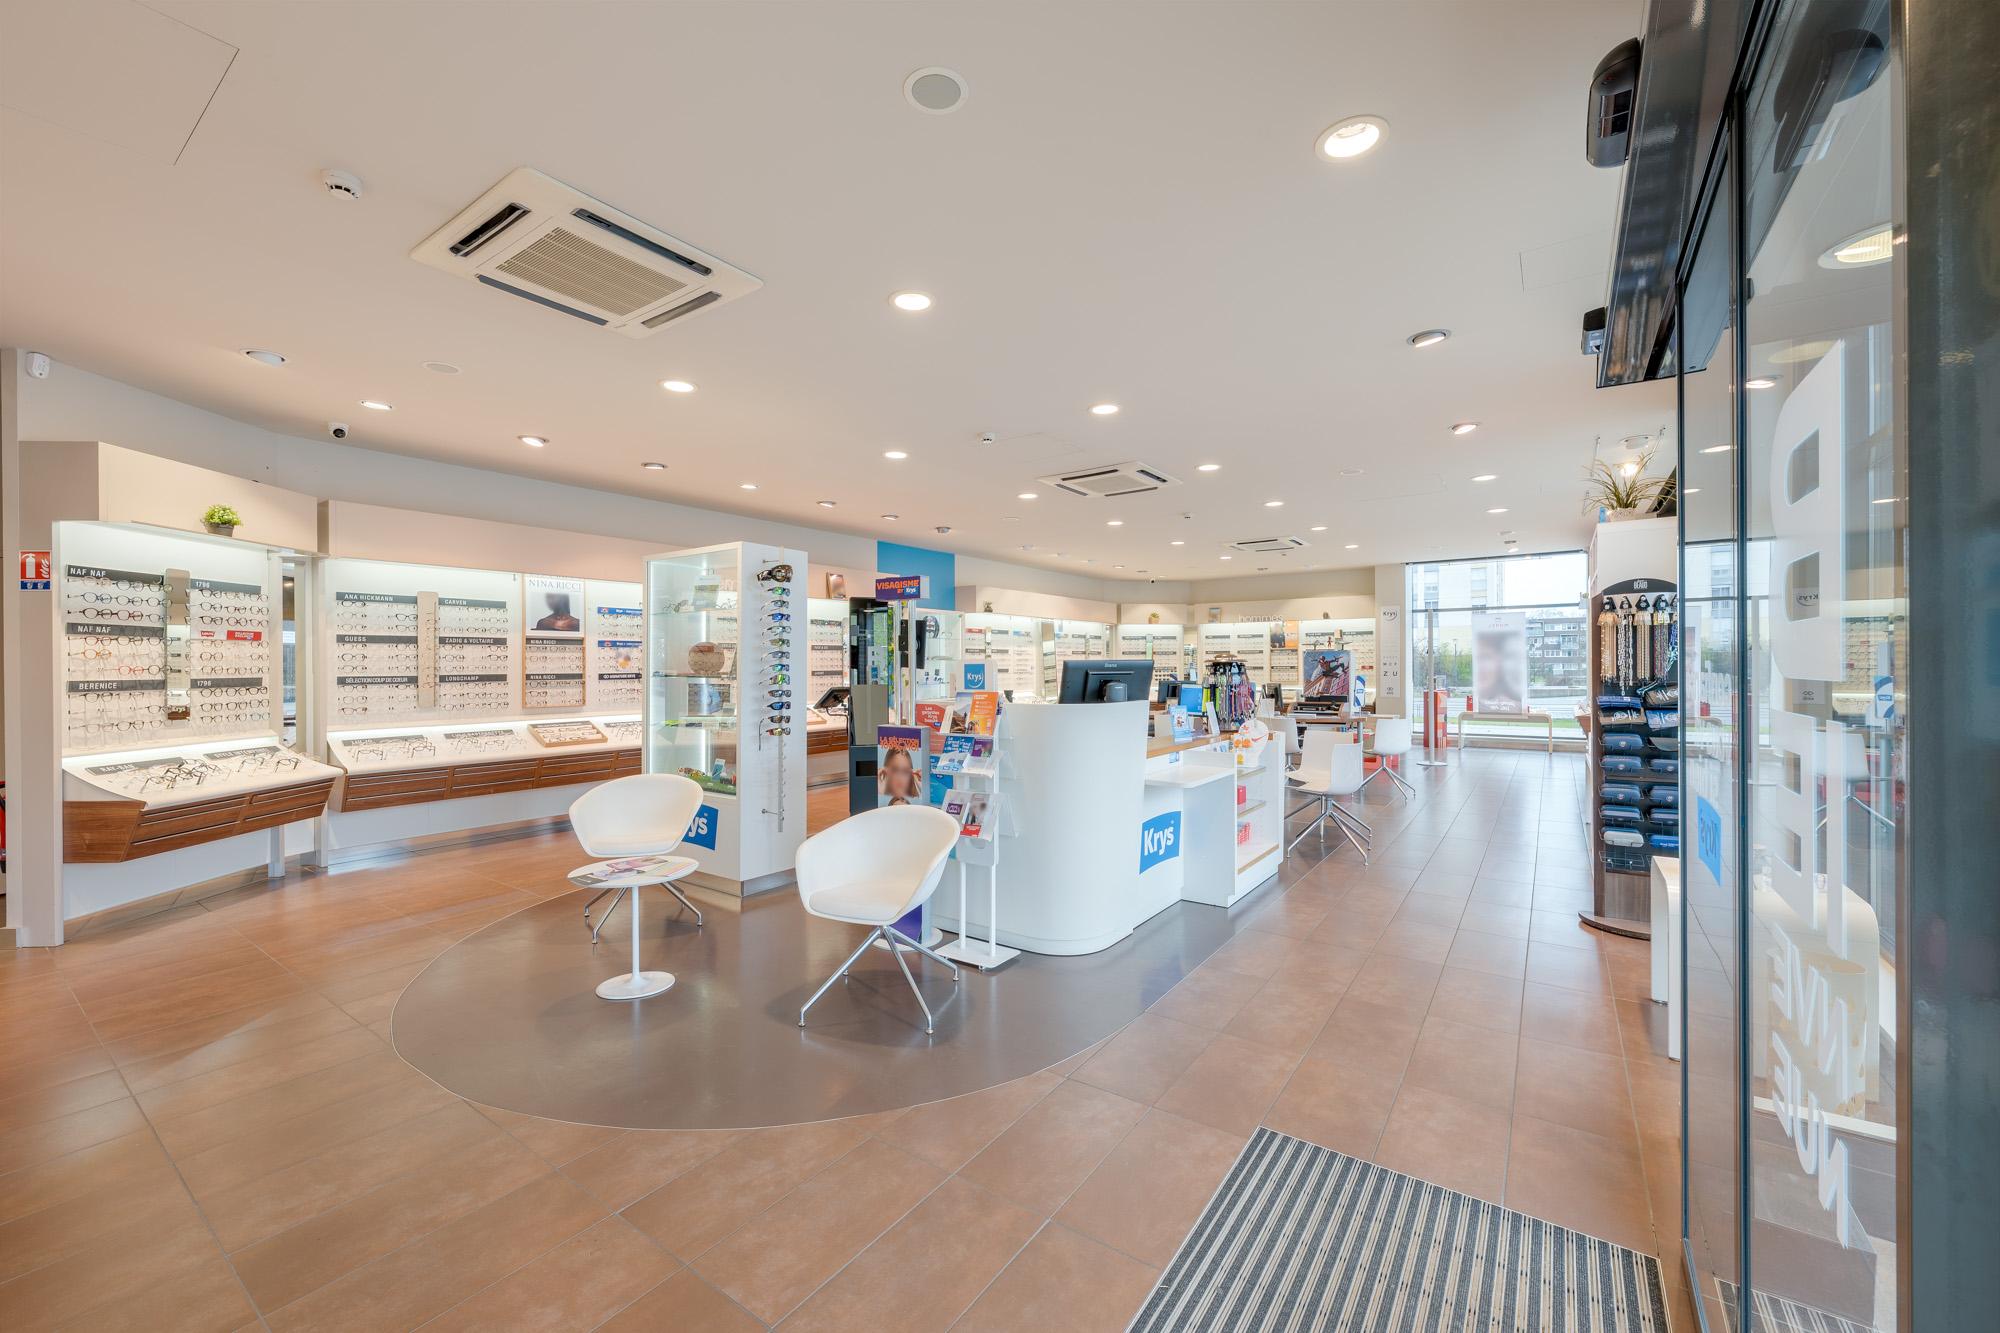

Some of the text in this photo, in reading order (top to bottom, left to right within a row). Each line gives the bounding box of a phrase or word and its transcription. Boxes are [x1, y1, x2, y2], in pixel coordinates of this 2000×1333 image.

[70, 567, 107, 577] NAF NAF
[529, 579, 581, 590] NINA RICCI
[876, 579, 920, 590] VISAGISME
[77, 625, 94, 633] NAF
[967, 672, 982, 683] Krys
[79, 682, 118, 690] BERENICE
[1143, 825, 1174, 857] Krys
